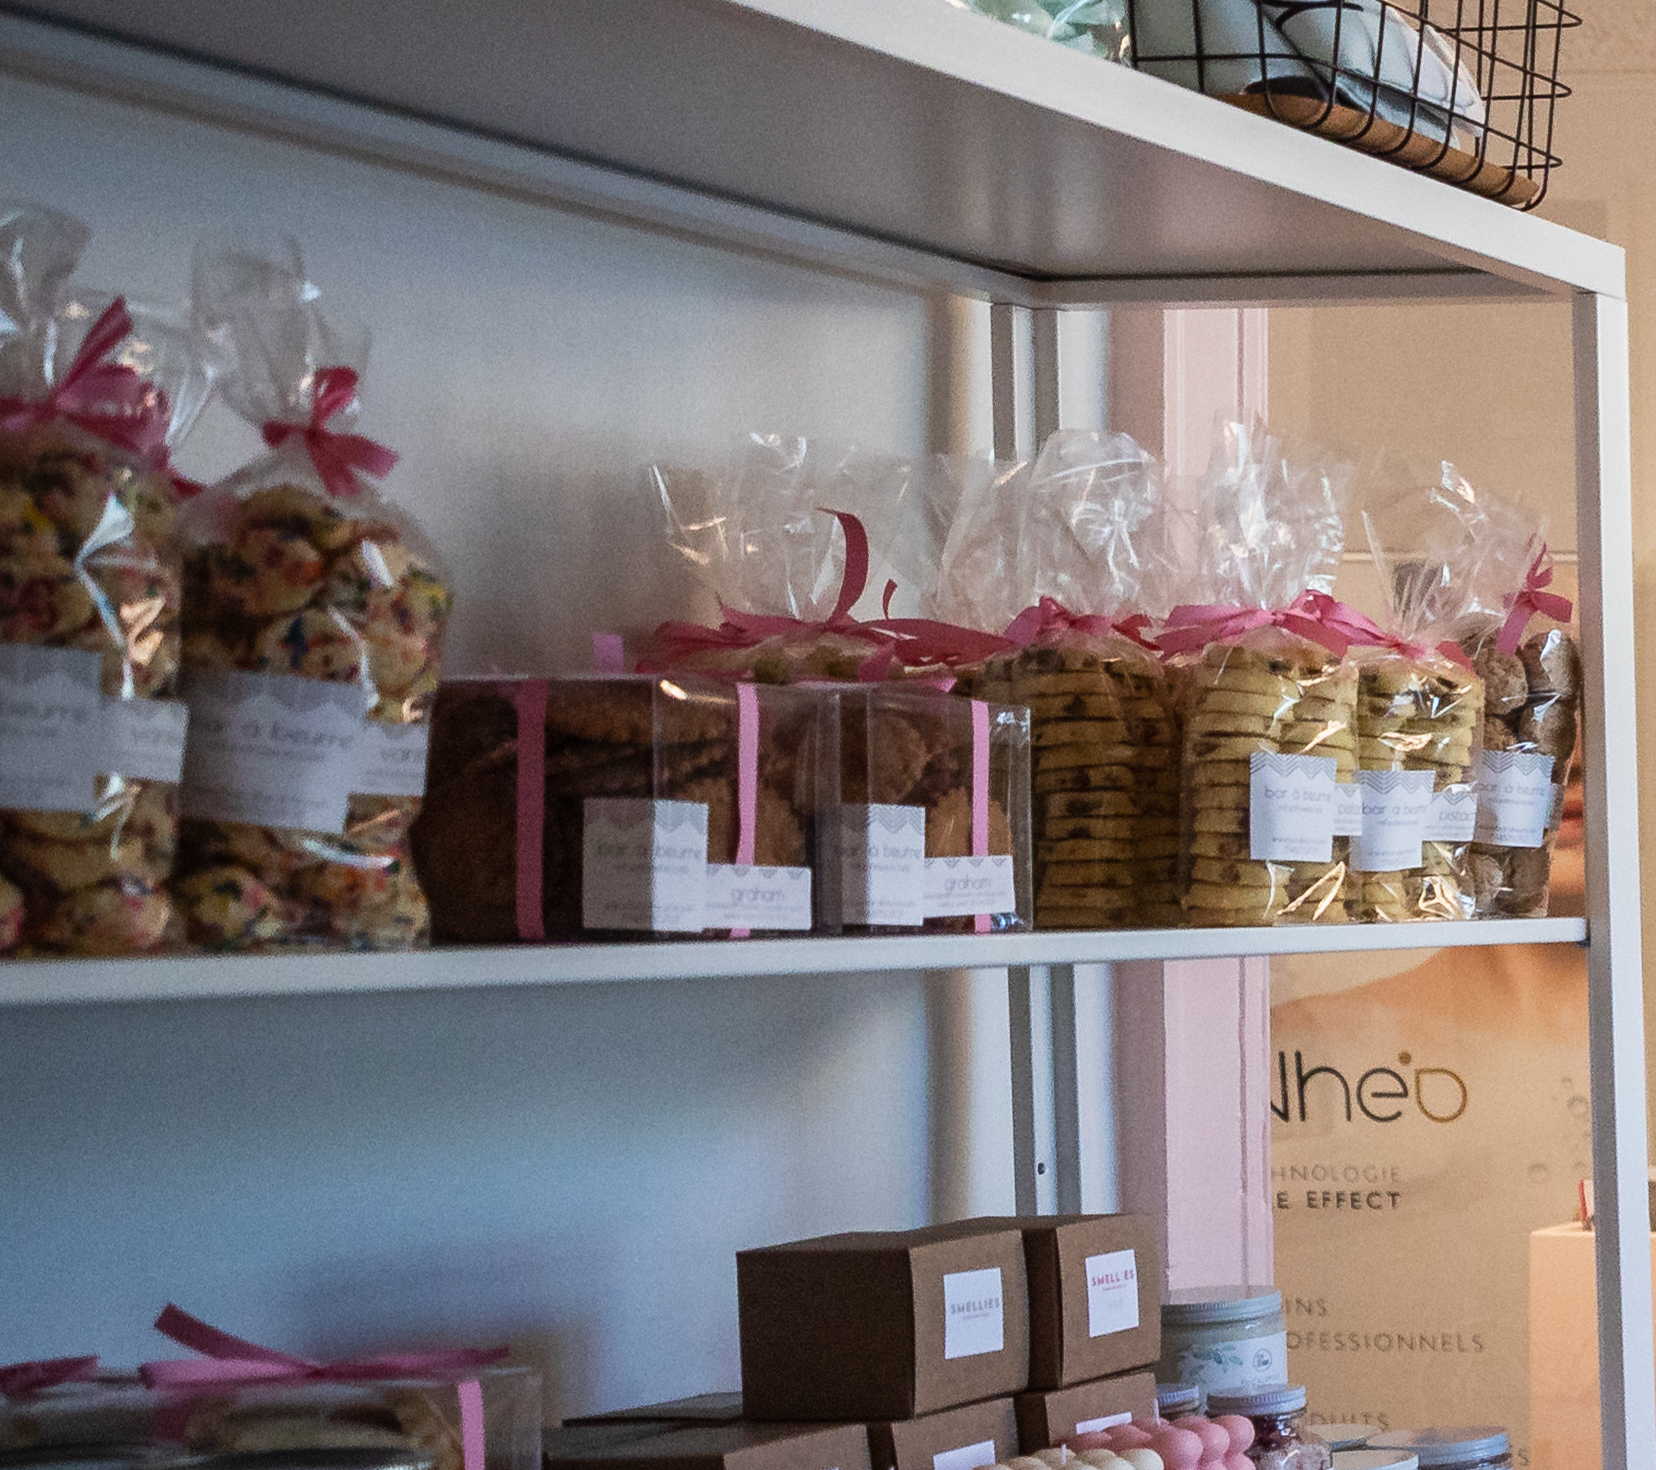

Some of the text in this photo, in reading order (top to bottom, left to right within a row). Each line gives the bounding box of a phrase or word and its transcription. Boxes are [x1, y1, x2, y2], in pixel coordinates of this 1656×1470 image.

[1264, 787, 1287, 800] bar
[1362, 804, 1387, 816] bar
[944, 875, 991, 893] graham
[731, 886, 786, 904] graham
[1306, 1190, 1402, 1211] EFFECT
[950, 1298, 1001, 1315] SMELLIES
[1285, 1332, 1486, 1355] OFESSIONNELS
